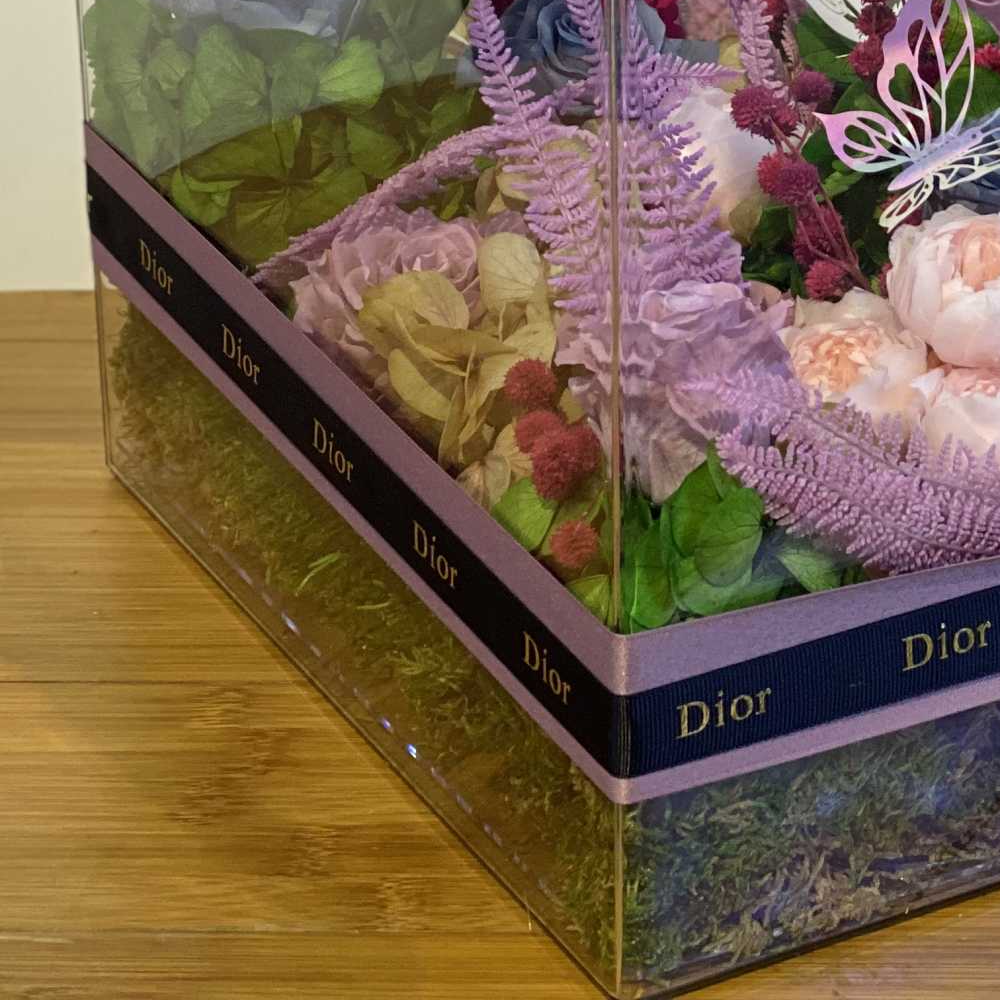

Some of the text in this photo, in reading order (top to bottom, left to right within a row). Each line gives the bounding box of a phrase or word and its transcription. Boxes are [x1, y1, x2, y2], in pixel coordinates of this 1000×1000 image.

[138, 239, 571, 704] Dior Dior Dior Dior Dior
[676, 687, 772, 738] Dior
[901, 618, 991, 671] Dior
